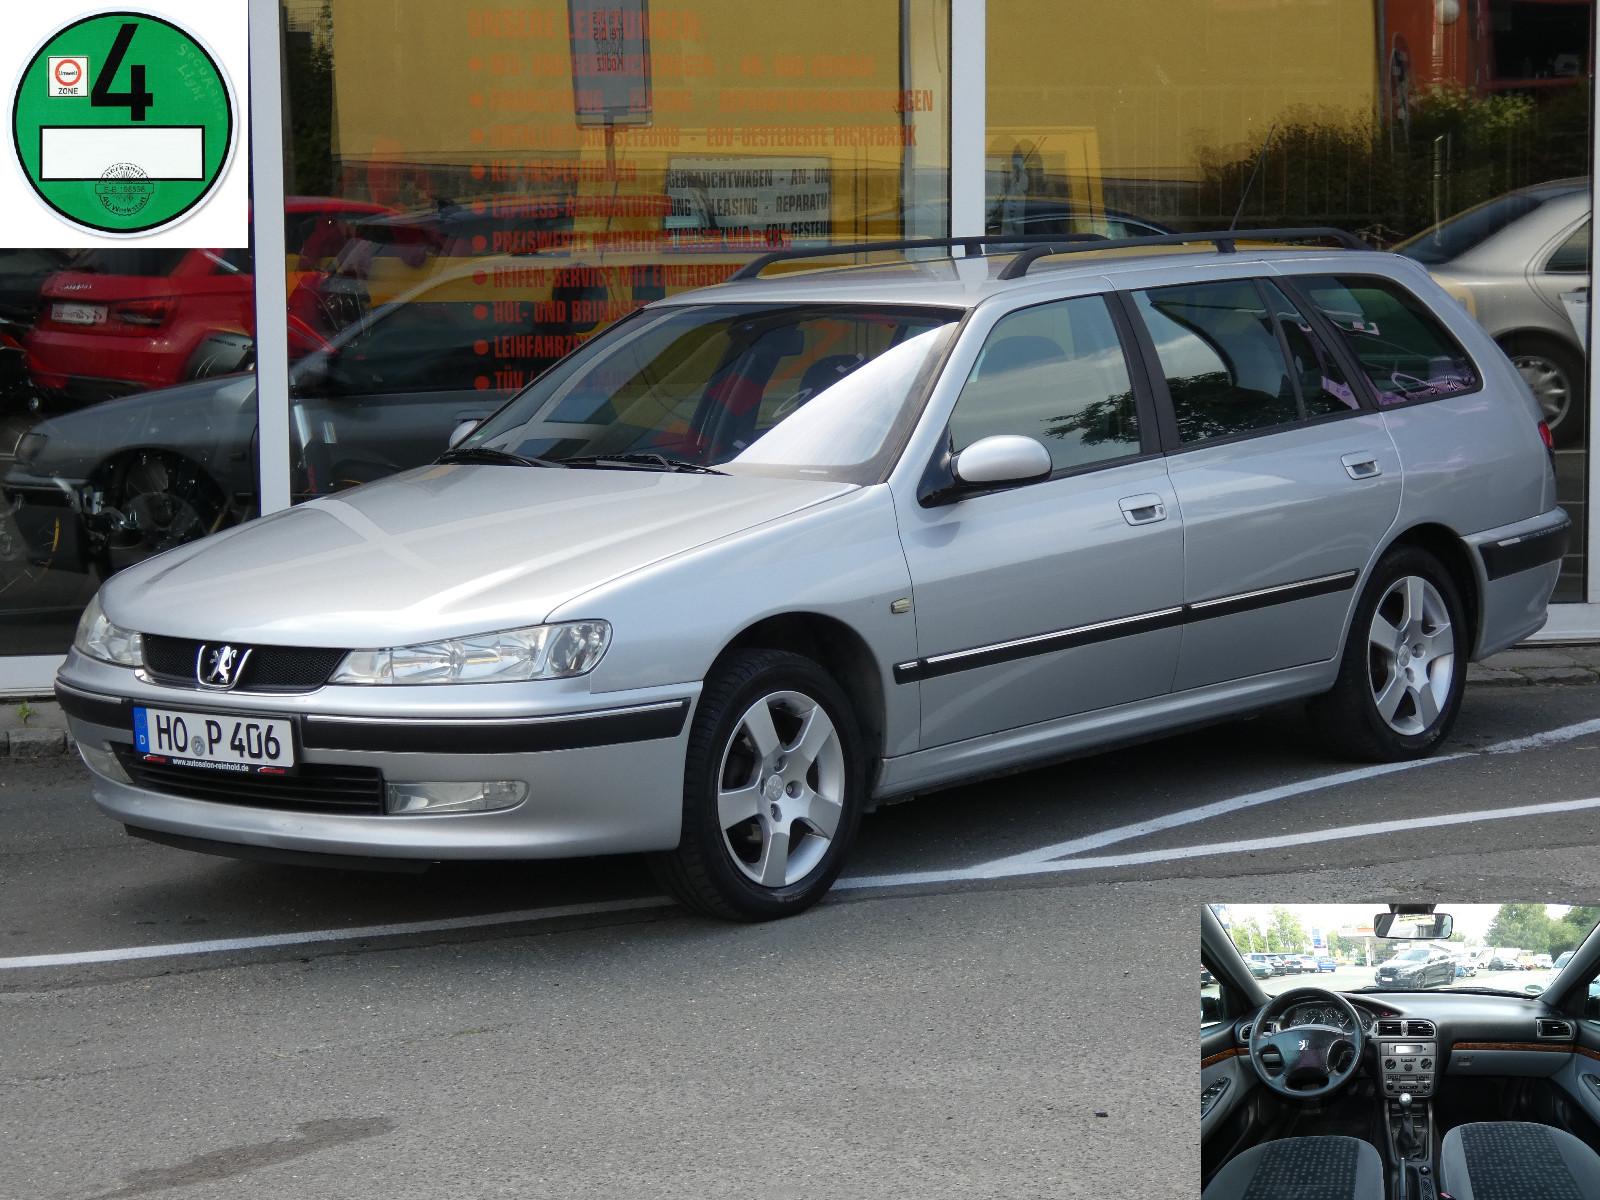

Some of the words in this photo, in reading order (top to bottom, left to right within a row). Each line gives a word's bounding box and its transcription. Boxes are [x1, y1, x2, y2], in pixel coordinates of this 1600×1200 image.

[669, 169, 774, 189] GEBUCHTWAGEN
[156, 714, 189, 753] HO
[205, 719, 223, 756] P
[230, 721, 281, 760] 406
[172, 757, 250, 773] www.autosalon-reinhold.de
